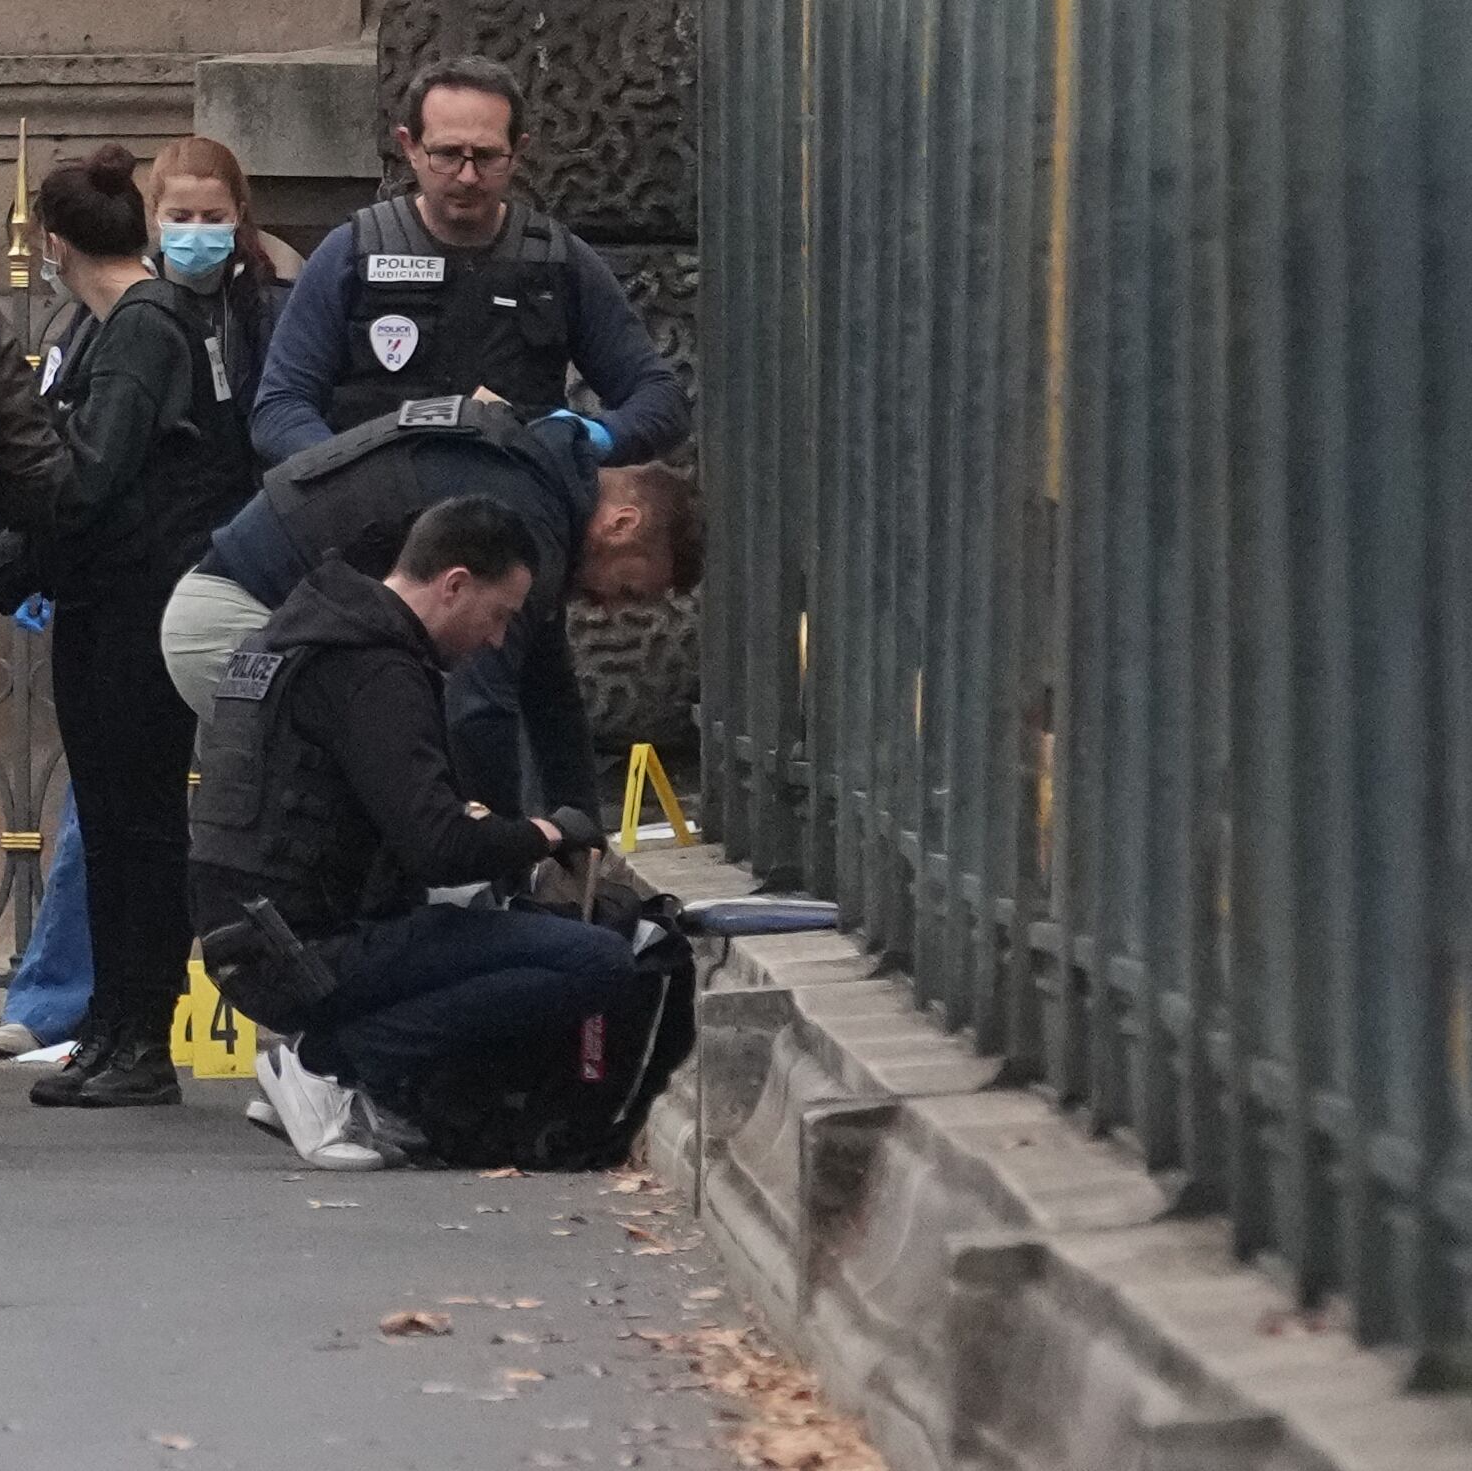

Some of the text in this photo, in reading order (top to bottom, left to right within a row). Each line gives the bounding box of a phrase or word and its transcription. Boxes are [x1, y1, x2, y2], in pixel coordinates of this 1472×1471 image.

[377, 258, 437, 270] POLICE
[370, 270, 442, 279] JUDICIAIRE
[387, 353, 402, 364] PJ
[210, 995, 238, 1055] 4
